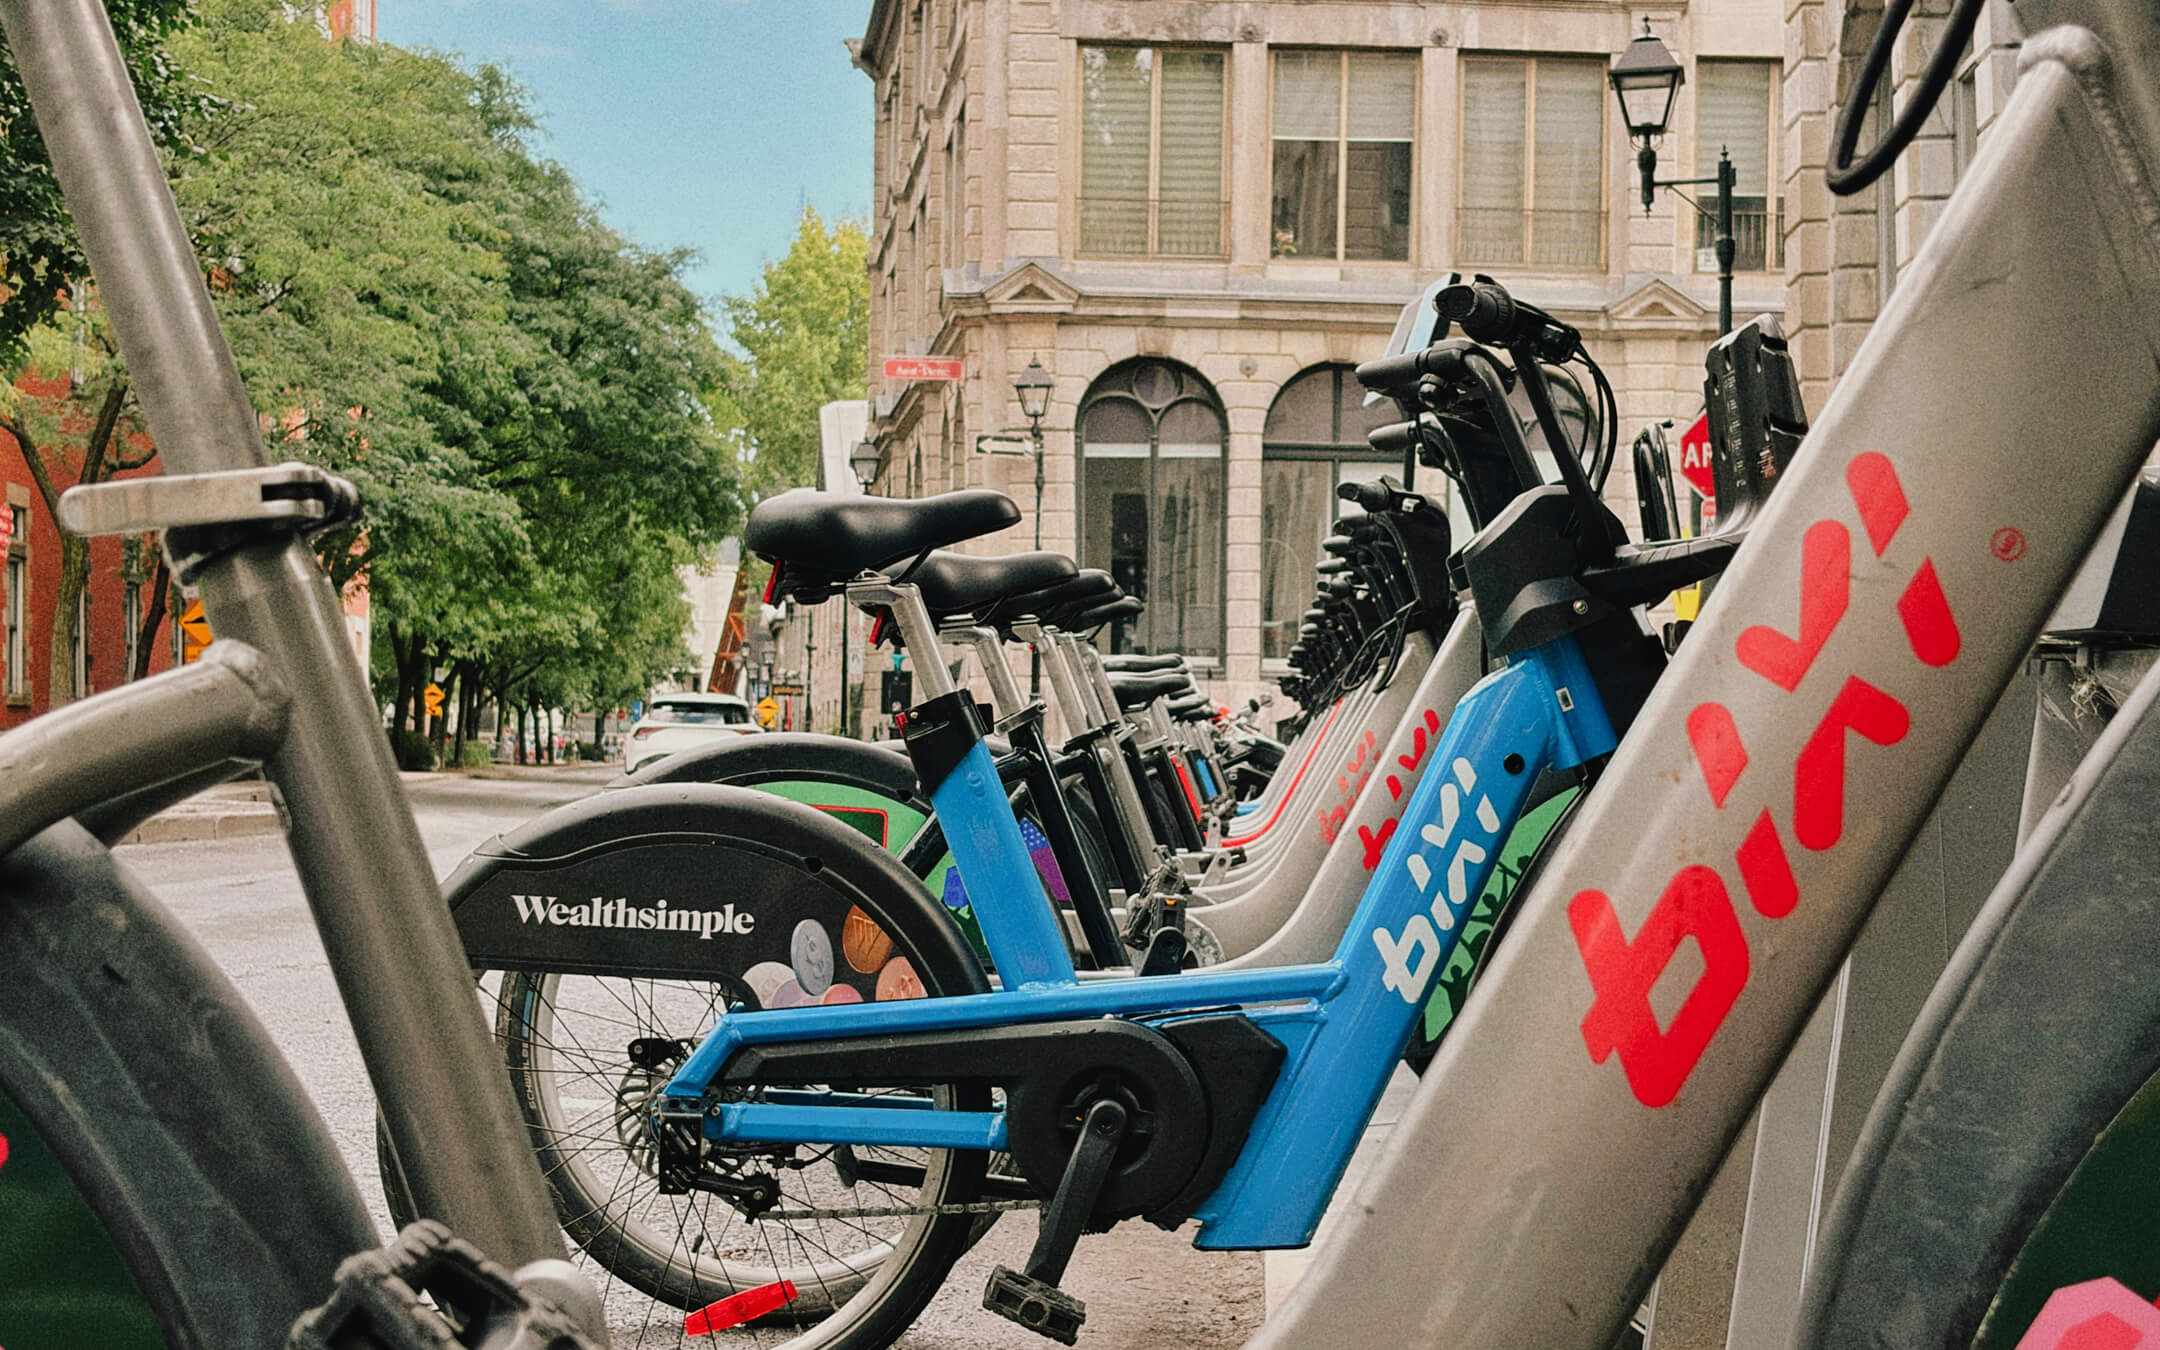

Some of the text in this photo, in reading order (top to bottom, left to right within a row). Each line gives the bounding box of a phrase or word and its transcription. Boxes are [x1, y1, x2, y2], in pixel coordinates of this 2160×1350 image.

[1372, 757, 1501, 1004] bixi
[1567, 451, 1961, 1107] bixi
[511, 894, 755, 940] Wealthsimple
